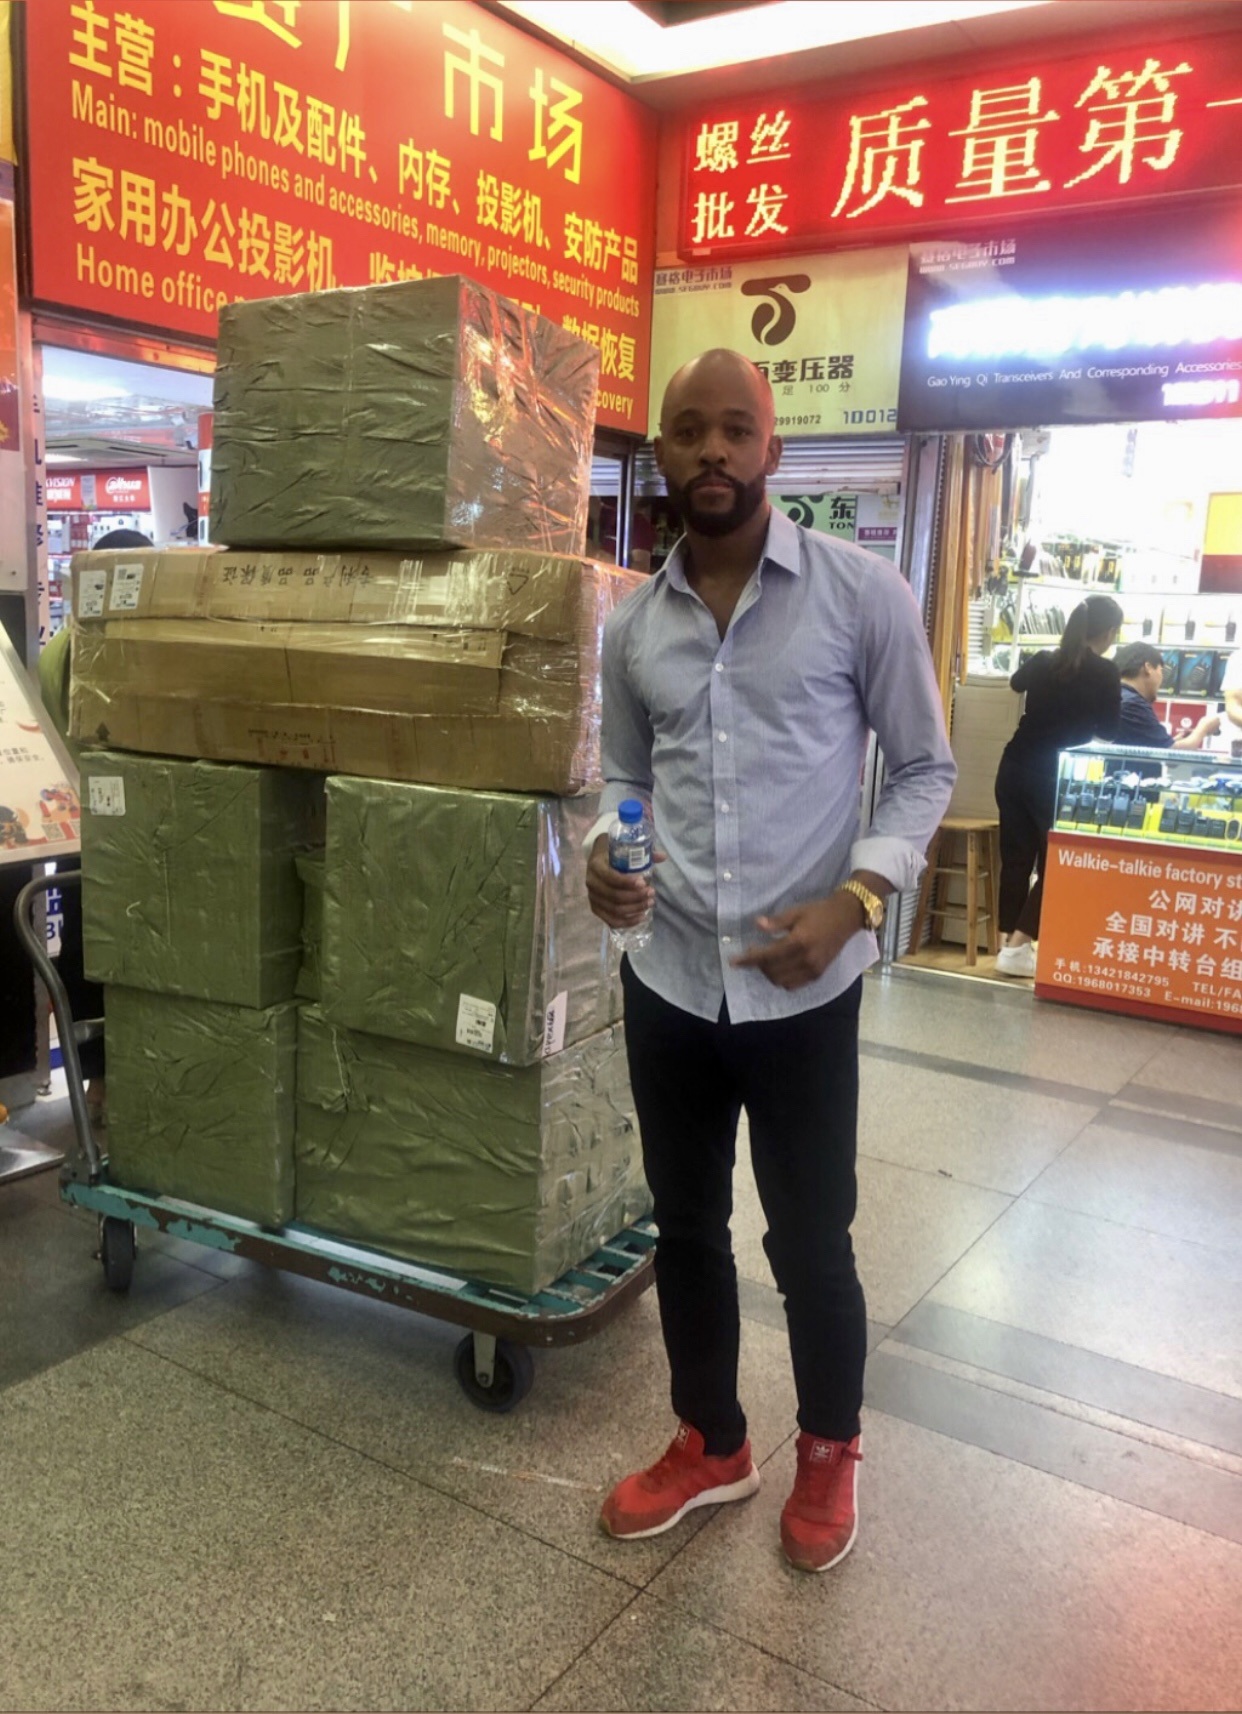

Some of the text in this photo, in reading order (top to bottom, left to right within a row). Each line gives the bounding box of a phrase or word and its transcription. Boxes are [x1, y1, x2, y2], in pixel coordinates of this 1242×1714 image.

[693, 110, 791, 173] 螺丝
[72, 79, 137, 139] Main:
[144, 119, 216, 166] mobile
[222, 140, 289, 193] phones
[294, 173, 325, 206] and
[329, 187, 422, 245] accessories,
[427, 222, 485, 267] memory,
[487, 245, 550, 290] projectors,
[552, 269, 595, 307] security
[596, 287, 640, 318] products
[691, 184, 788, 243] 批发
[77, 242, 228, 313] Home office
[927, 359, 1242, 389] Gao Ying Qi Transceivers And Corresponding Accessories
[1058, 849, 1162, 878] Walkie-talkie
[1165, 863, 1223, 890] factory
[1105, 911, 1205, 946] 全国对讲
